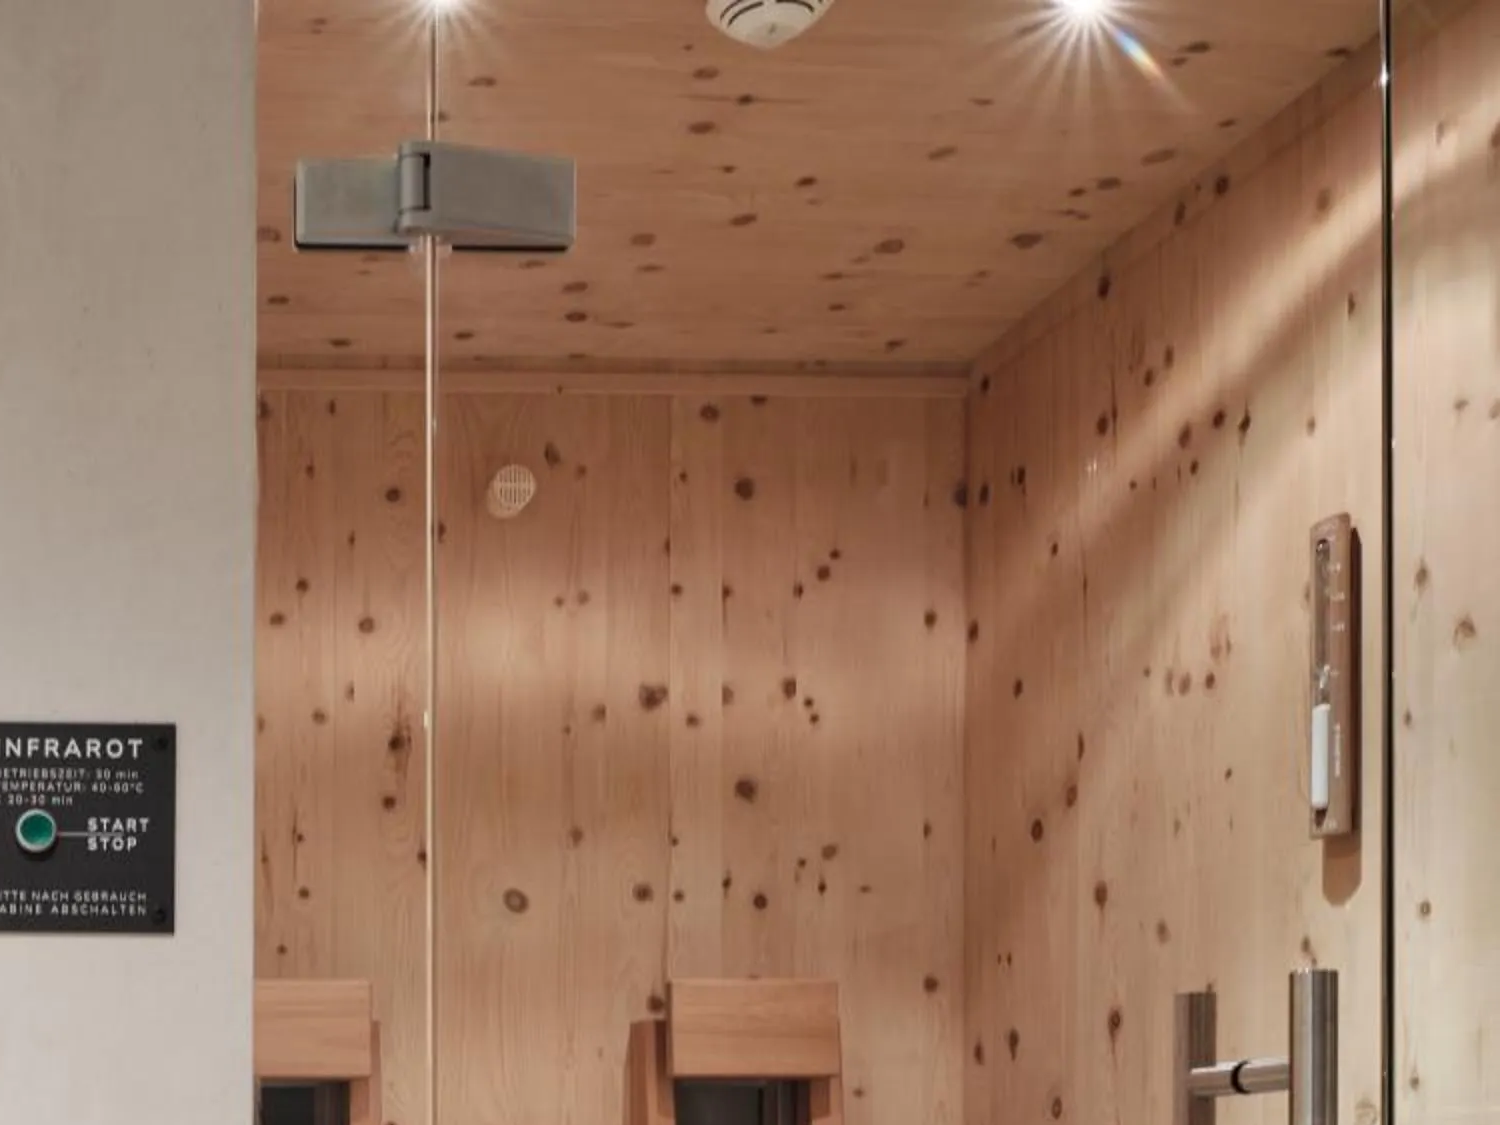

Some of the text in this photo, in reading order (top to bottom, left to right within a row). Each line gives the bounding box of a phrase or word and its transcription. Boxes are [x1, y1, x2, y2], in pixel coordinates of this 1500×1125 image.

[115, 769, 139, 779] min
[51, 795, 73, 805] min
[87, 818, 149, 833] START
[87, 836, 137, 851] STOP
[32, 890, 69, 902] NACH
[74, 890, 147, 902] GEBRAUCH
[51, 903, 147, 915] ABSCHALTEN
